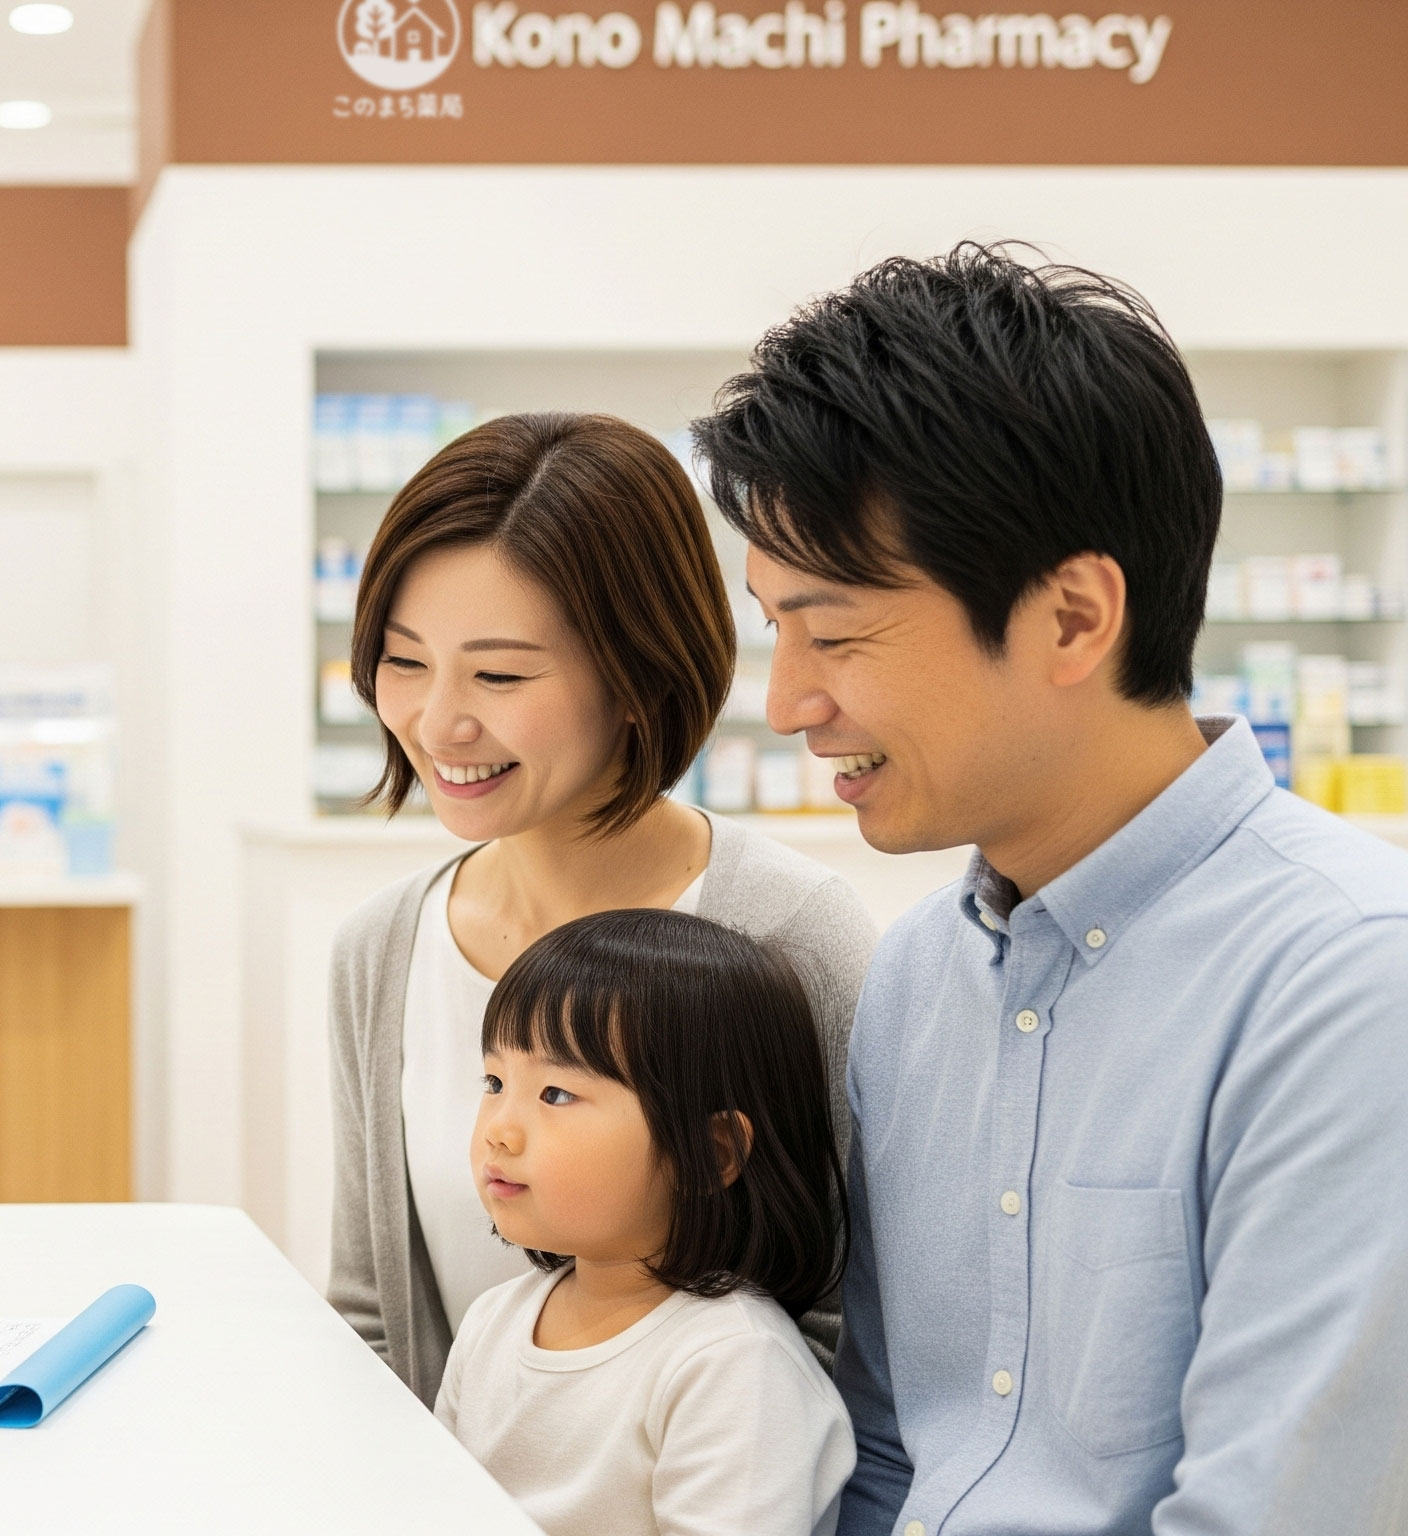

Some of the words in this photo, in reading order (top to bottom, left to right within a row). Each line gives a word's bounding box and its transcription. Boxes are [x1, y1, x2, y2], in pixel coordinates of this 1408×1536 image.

[473, 3, 640, 67] Kono
[654, 1, 845, 67] Machi
[861, 2, 1171, 82] Pharmacy
